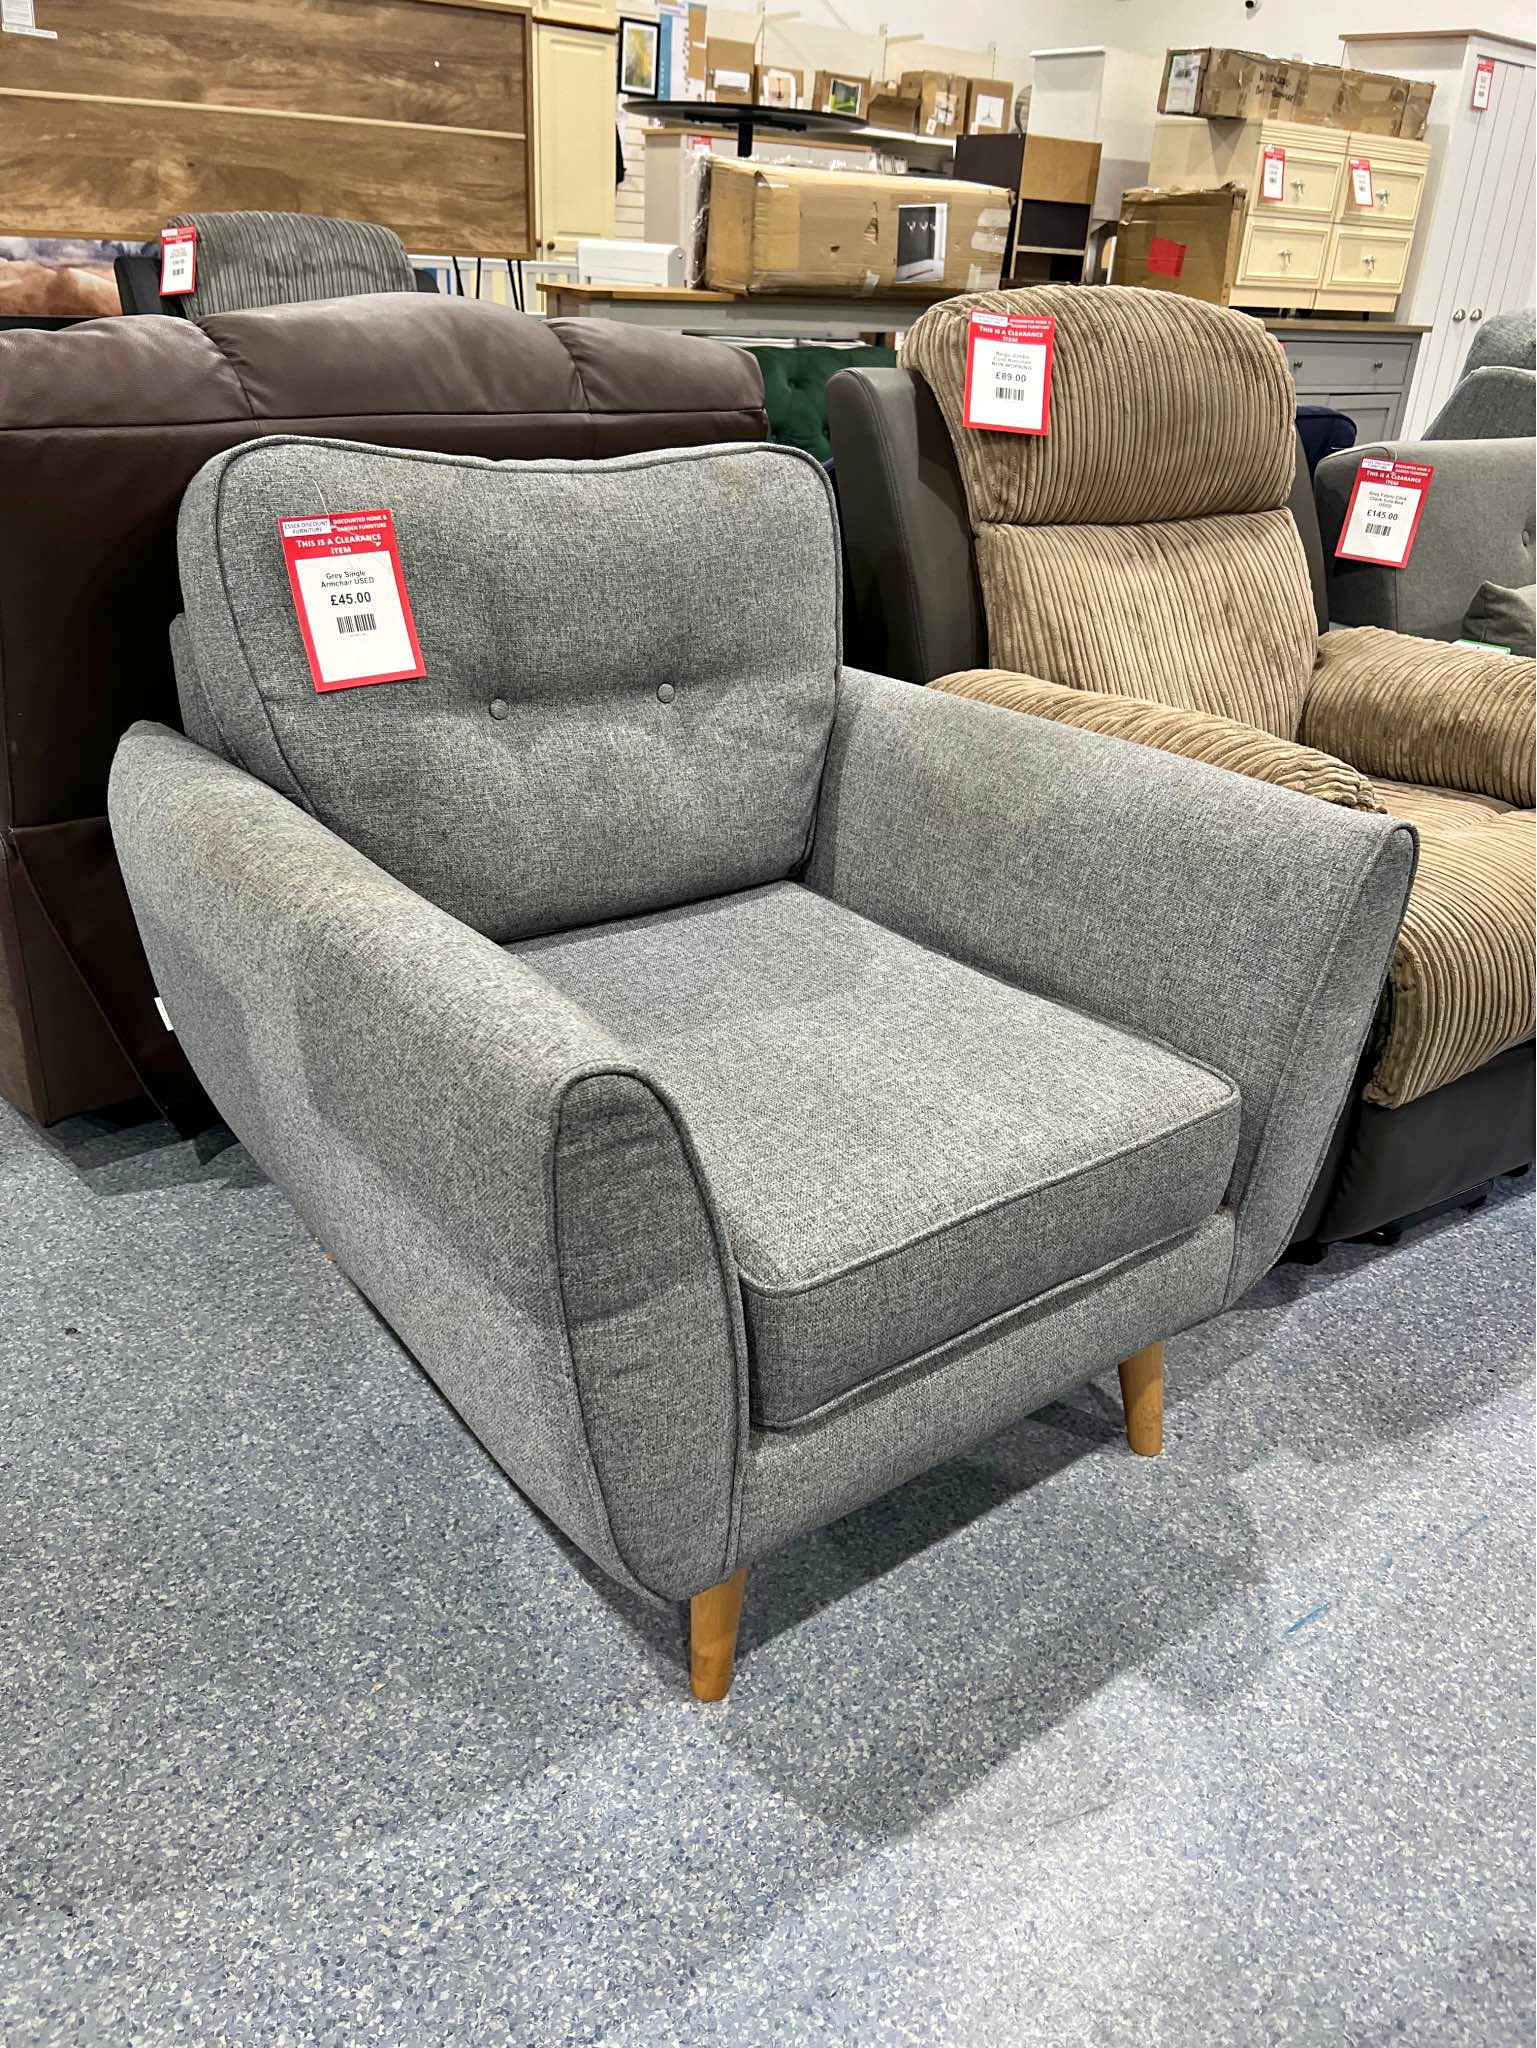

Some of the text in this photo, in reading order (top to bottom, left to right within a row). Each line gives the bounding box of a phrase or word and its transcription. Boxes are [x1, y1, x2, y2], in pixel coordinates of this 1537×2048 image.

[979, 325, 993, 333] THIS
[1008, 330, 1043, 338] CLEARANCE
[995, 371, 1026, 383] £89.00
[1391, 474, 1421, 483] CLEARANCE
[1366, 509, 1398, 521] £145.00
[301, 520, 328, 528] DISCOUNT
[296, 533, 381, 548] THIS IS A CLEARANCE
[330, 546, 352, 554] ITEM
[325, 570, 366, 580] Grey Single
[321, 576, 375, 588] Armchair USED
[330, 591, 371, 606] £45.00
